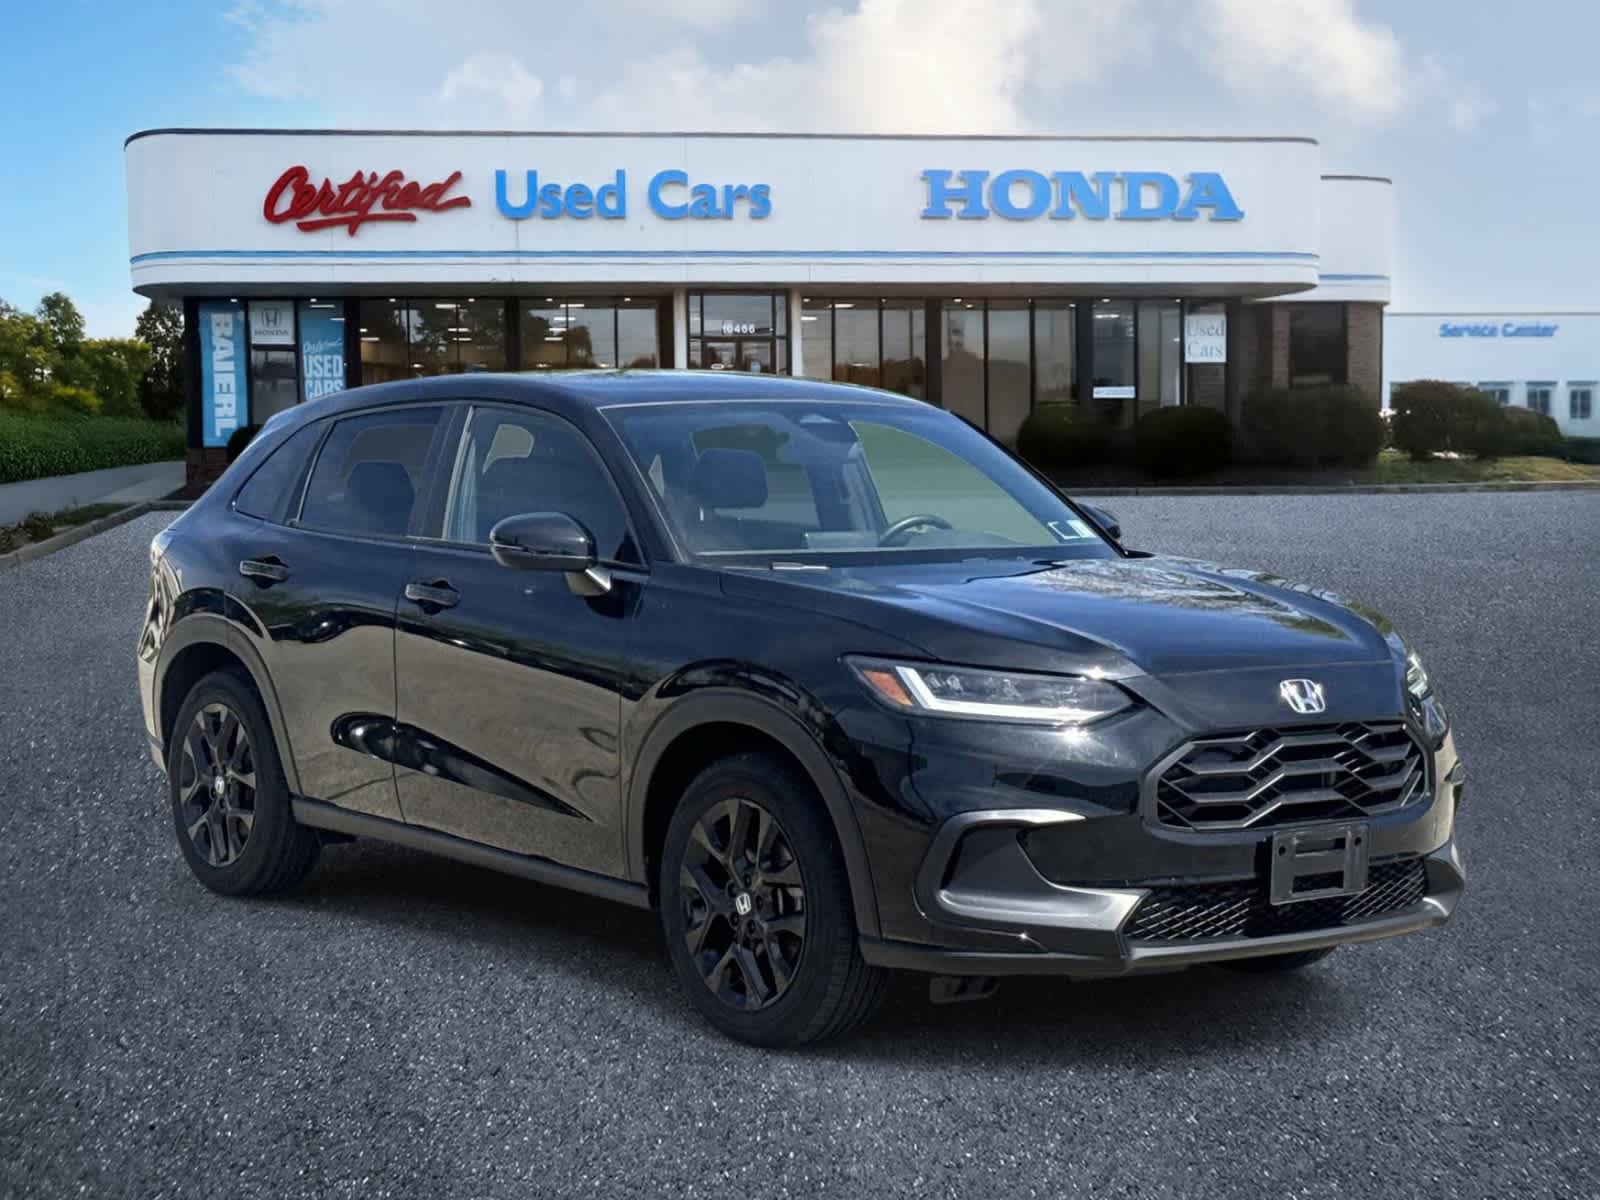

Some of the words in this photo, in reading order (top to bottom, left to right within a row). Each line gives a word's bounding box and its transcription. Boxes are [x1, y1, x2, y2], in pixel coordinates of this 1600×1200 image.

[264, 166, 472, 236] Certified
[495, 169, 626, 219] Used
[648, 169, 772, 220] Cars
[920, 169, 1245, 221] HONDA
[1186, 318, 1225, 337] Used
[303, 355, 343, 378] USED
[1186, 341, 1224, 358] Cars
[210, 313, 238, 438] BAIERL
